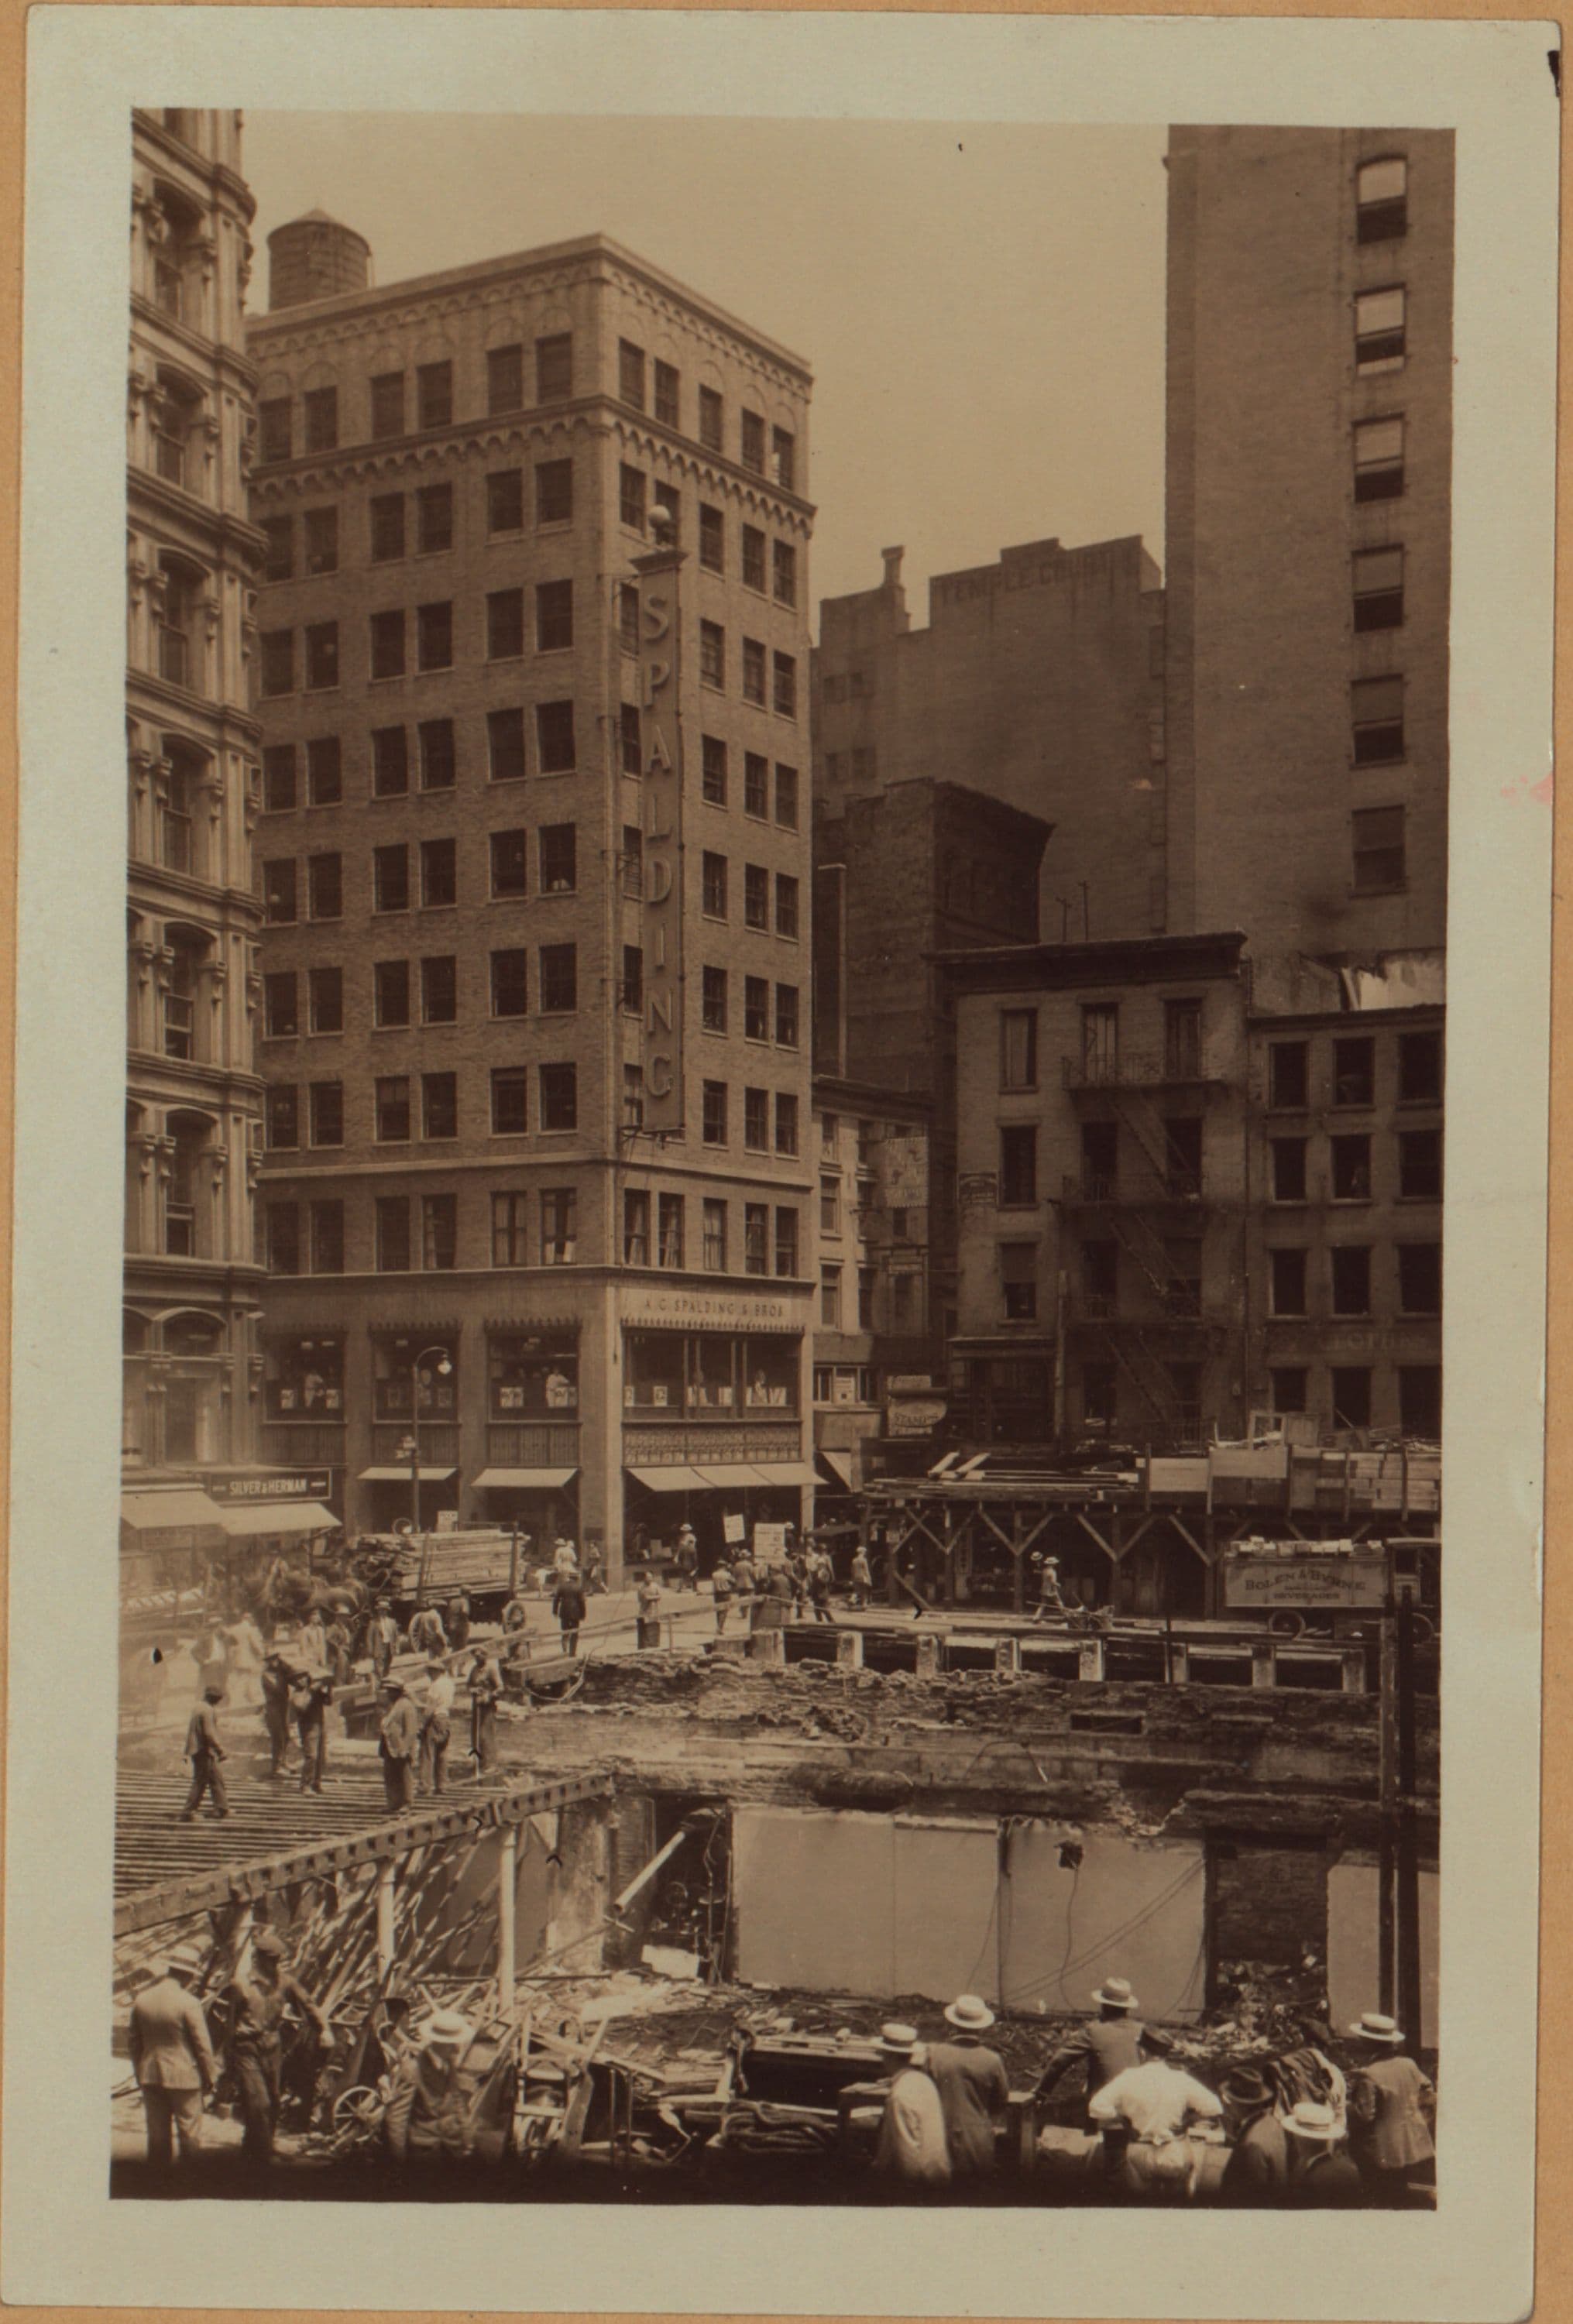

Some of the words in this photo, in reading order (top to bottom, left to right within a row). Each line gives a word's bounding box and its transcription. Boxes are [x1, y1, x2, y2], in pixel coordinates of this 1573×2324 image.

[643, 594, 675, 1098] SPALDING
[675, 1299, 735, 1315] SPALDING
[229, 1480, 261, 1496] SILVER
[268, 1478, 307, 1494] HERMAN
